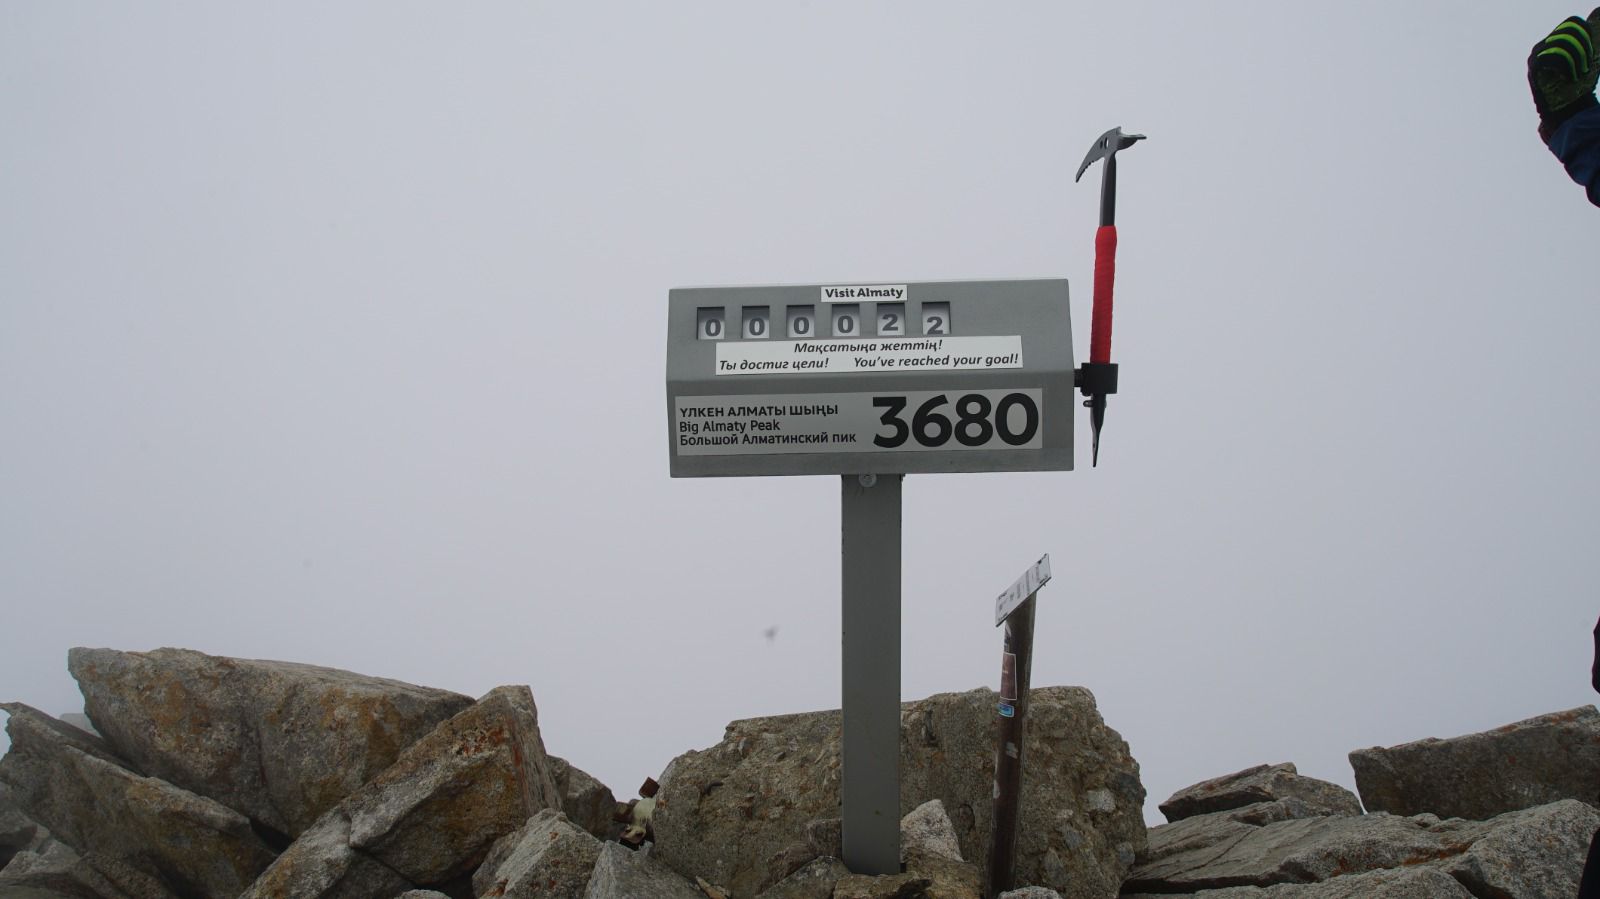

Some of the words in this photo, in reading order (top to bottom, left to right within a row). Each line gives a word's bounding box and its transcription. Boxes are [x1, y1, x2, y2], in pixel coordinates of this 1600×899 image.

[825, 288, 855, 298] Visit
[857, 287, 904, 299] Almaty
[794, 342, 877, 354] Мақсатыңа
[880, 339, 943, 353] жеттің!
[719, 360, 736, 371] Ты
[740, 360, 789, 371] достиг
[792, 358, 829, 370] цели!
[899, 355, 950, 367] reached
[953, 356, 983, 368] your
[985, 353, 1019, 367] goal!
[727, 405, 786, 416] АЛМАТЫ
[789, 405, 838, 417] ШЫҢЫ
[679, 421, 699, 434] Big
[702, 421, 747, 434] Almaty
[750, 419, 781, 431] Peak
[872, 392, 1038, 448] 3680
[680, 433, 738, 446] Большой
[742, 431, 828, 445] Алматинский
[832, 433, 857, 443] пик
